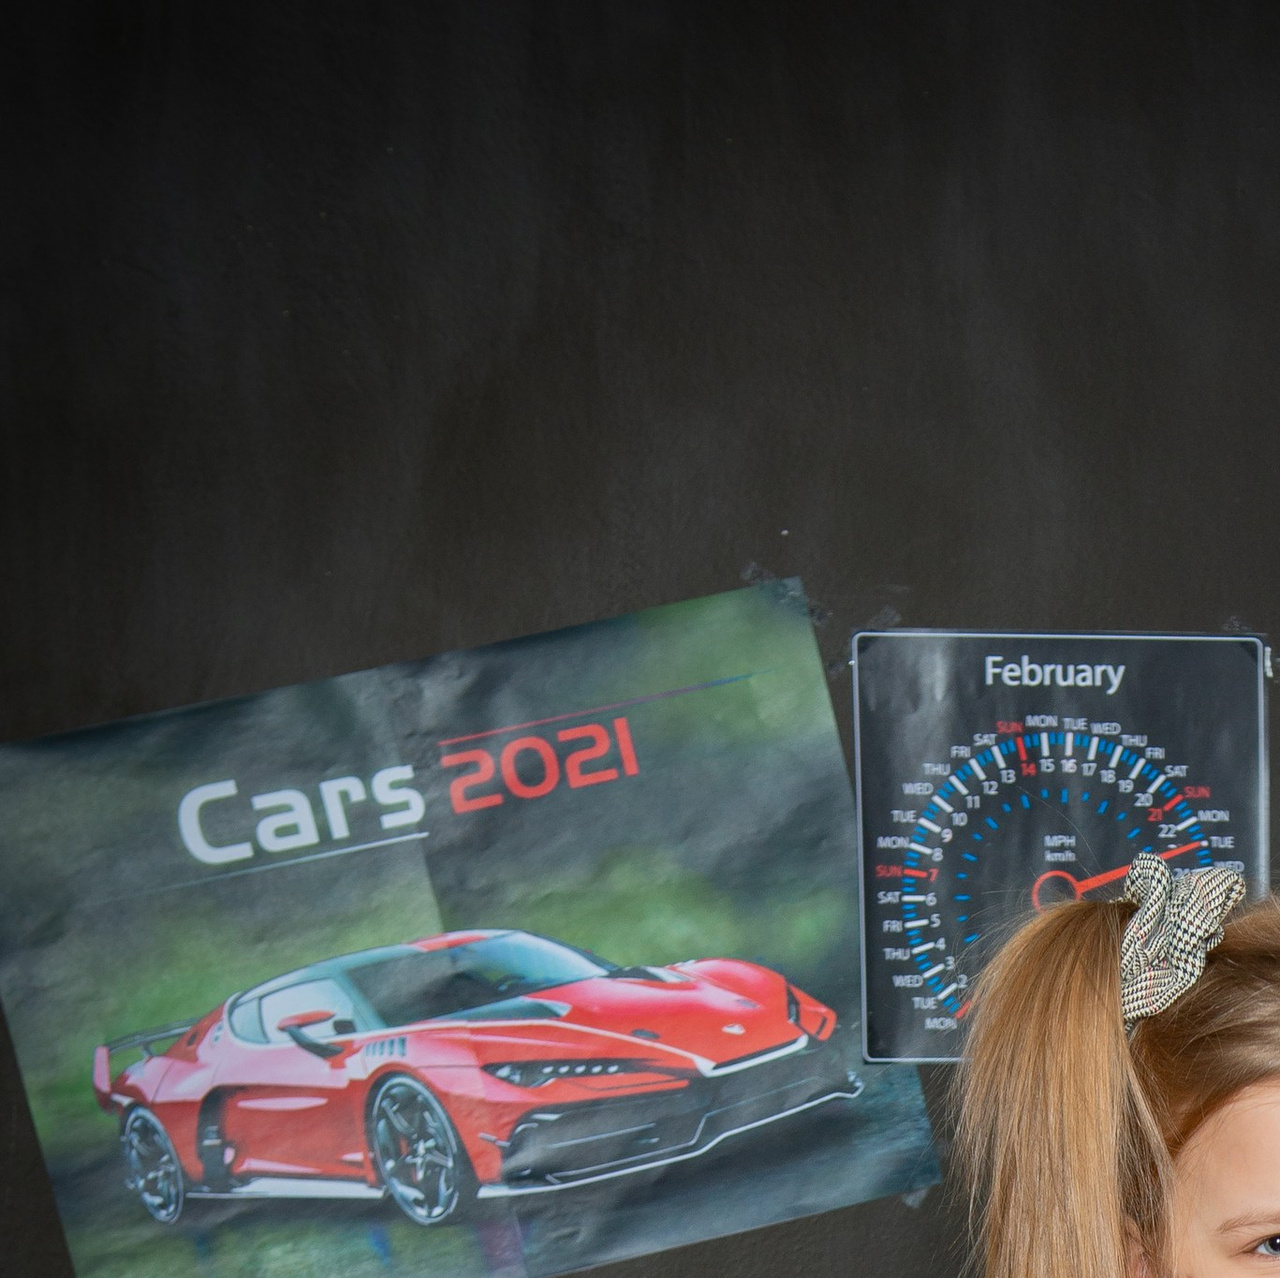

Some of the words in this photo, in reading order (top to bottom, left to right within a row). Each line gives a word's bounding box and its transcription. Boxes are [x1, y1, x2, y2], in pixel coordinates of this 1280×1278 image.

[985, 654, 1126, 695] February
[996, 720, 1024, 734] SUN
[1025, 715, 1058, 728] MON
[1062, 717, 1088, 730] TUE
[1090, 722, 1122, 735] WED
[973, 733, 998, 746] SAT
[1119, 734, 1148, 747] THU
[950, 745, 971, 758] FRI
[1145, 747, 1165, 759] FRI
[922, 763, 950, 775] THU
[1020, 763, 1036, 777] 14
[1039, 758, 1055, 773] 15
[1060, 759, 1077, 773] 16
[1081, 762, 1097, 776] 17
[1164, 765, 1189, 778] SAT
[1000, 769, 1016, 784] 13
[1100, 769, 1116, 783] 18
[177, 764, 426, 865] Cars
[440, 717, 640, 815] 2021
[902, 782, 934, 795] WED
[981, 781, 999, 795] 12
[1117, 779, 1134, 793] 19
[1183, 786, 1211, 798] SUN
[964, 795, 980, 809] 11
[1133, 792, 1153, 807] 20
[891, 810, 917, 823] TUE
[951, 812, 968, 827] 10
[1147, 808, 1163, 822] 21
[1197, 809, 1230, 822] MON
[941, 828, 953, 843] 9
[1158, 823, 1177, 838] 22
[877, 836, 910, 849] MON
[1044, 834, 1076, 848] MPH
[1209, 836, 1235, 849] TUE
[932, 847, 943, 862] 8
[875, 864, 903, 878] SUN
[928, 868, 939, 883] 7
[877, 891, 901, 904] SAT
[925, 892, 937, 907] 6
[882, 920, 903, 933] FRI
[930, 913, 941, 928] 5
[935, 937, 946, 951] 4
[883, 948, 911, 961] THU
[944, 956, 955, 971] 3
[892, 975, 923, 988] WED
[957, 974, 968, 989] 2
[912, 997, 937, 1010] TUE
[924, 1017, 957, 1030] MON
